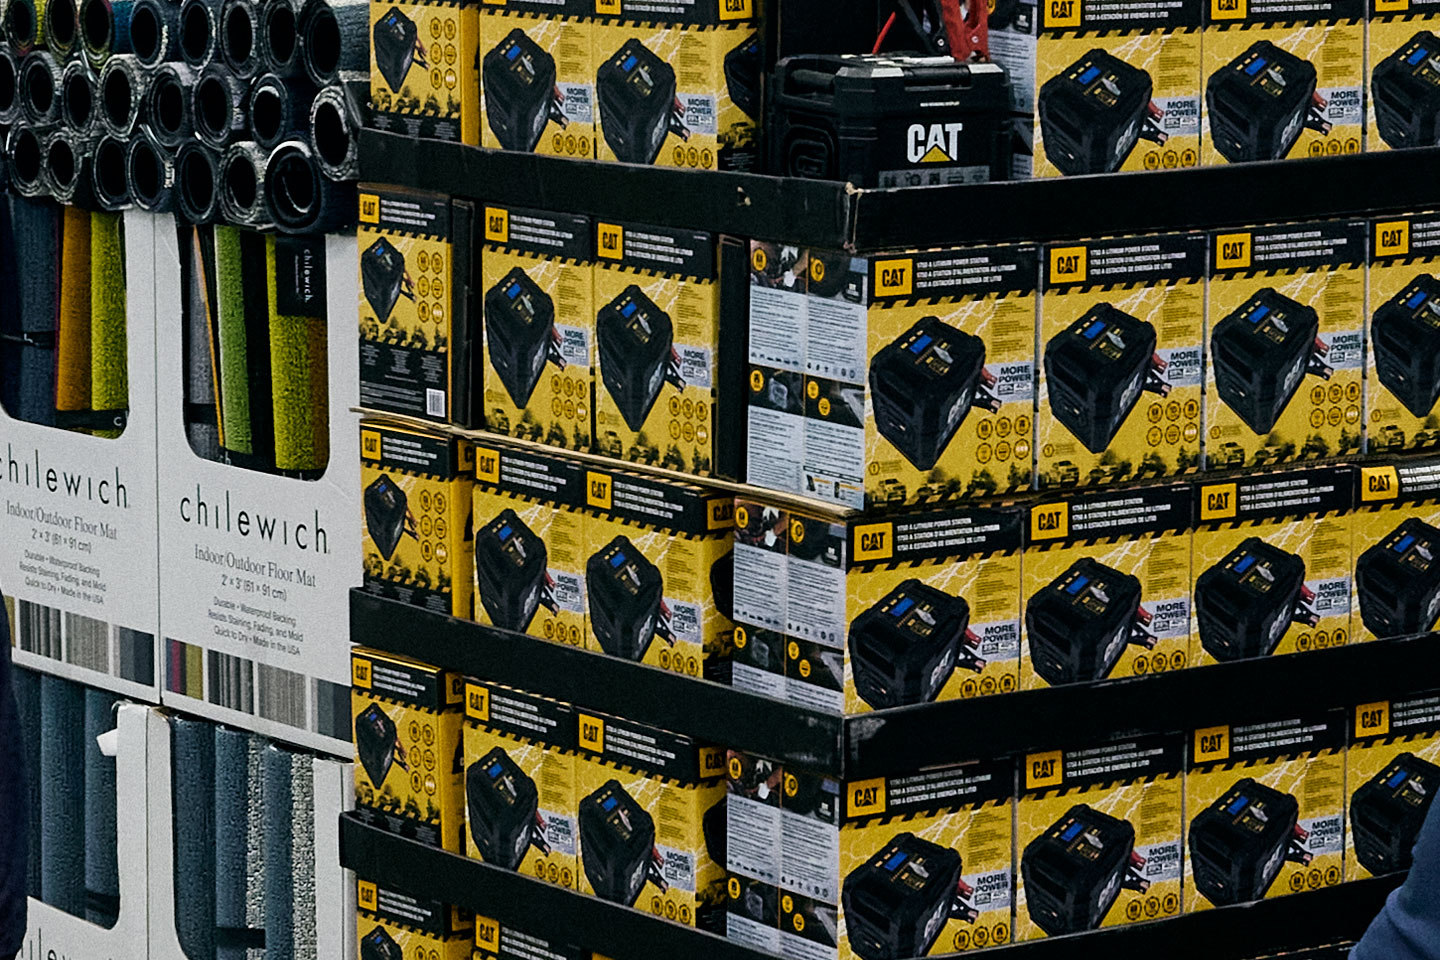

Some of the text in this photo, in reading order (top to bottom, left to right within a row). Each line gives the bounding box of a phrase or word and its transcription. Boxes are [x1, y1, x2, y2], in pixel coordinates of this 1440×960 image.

[907, 123, 962, 163] CAT
[602, 232, 618, 250] CAT
[1382, 229, 1403, 248] CAT
[1223, 242, 1245, 260] CAT
[1057, 255, 1080, 274] CAT
[304, 249, 313, 302] chilewich
[882, 268, 906, 287] CAT
[998, 373, 1031, 383] POWER
[1000, 365, 1030, 376] MORE
[0, 443, 127, 508] hilewich
[1368, 475, 1390, 493] CAT
[591, 480, 607, 499] CAT
[1208, 492, 1230, 511] CAT
[6, 500, 117, 540] Indoor/Outdoor Floor Mat
[180, 484, 328, 554] chilewich
[1038, 511, 1062, 531] CAT
[861, 532, 886, 552] CAT
[195, 544, 316, 587] Indoor/Outdoor Floor Mat
[982, 632, 1017, 643] POWER
[984, 624, 1015, 634] MORE
[1362, 709, 1383, 728] CAT
[1200, 733, 1224, 753] CAT
[1033, 759, 1056, 779] CAT
[854, 786, 879, 807] CAT
[974, 881, 1009, 892] POWER
[976, 873, 1007, 884] MORE
